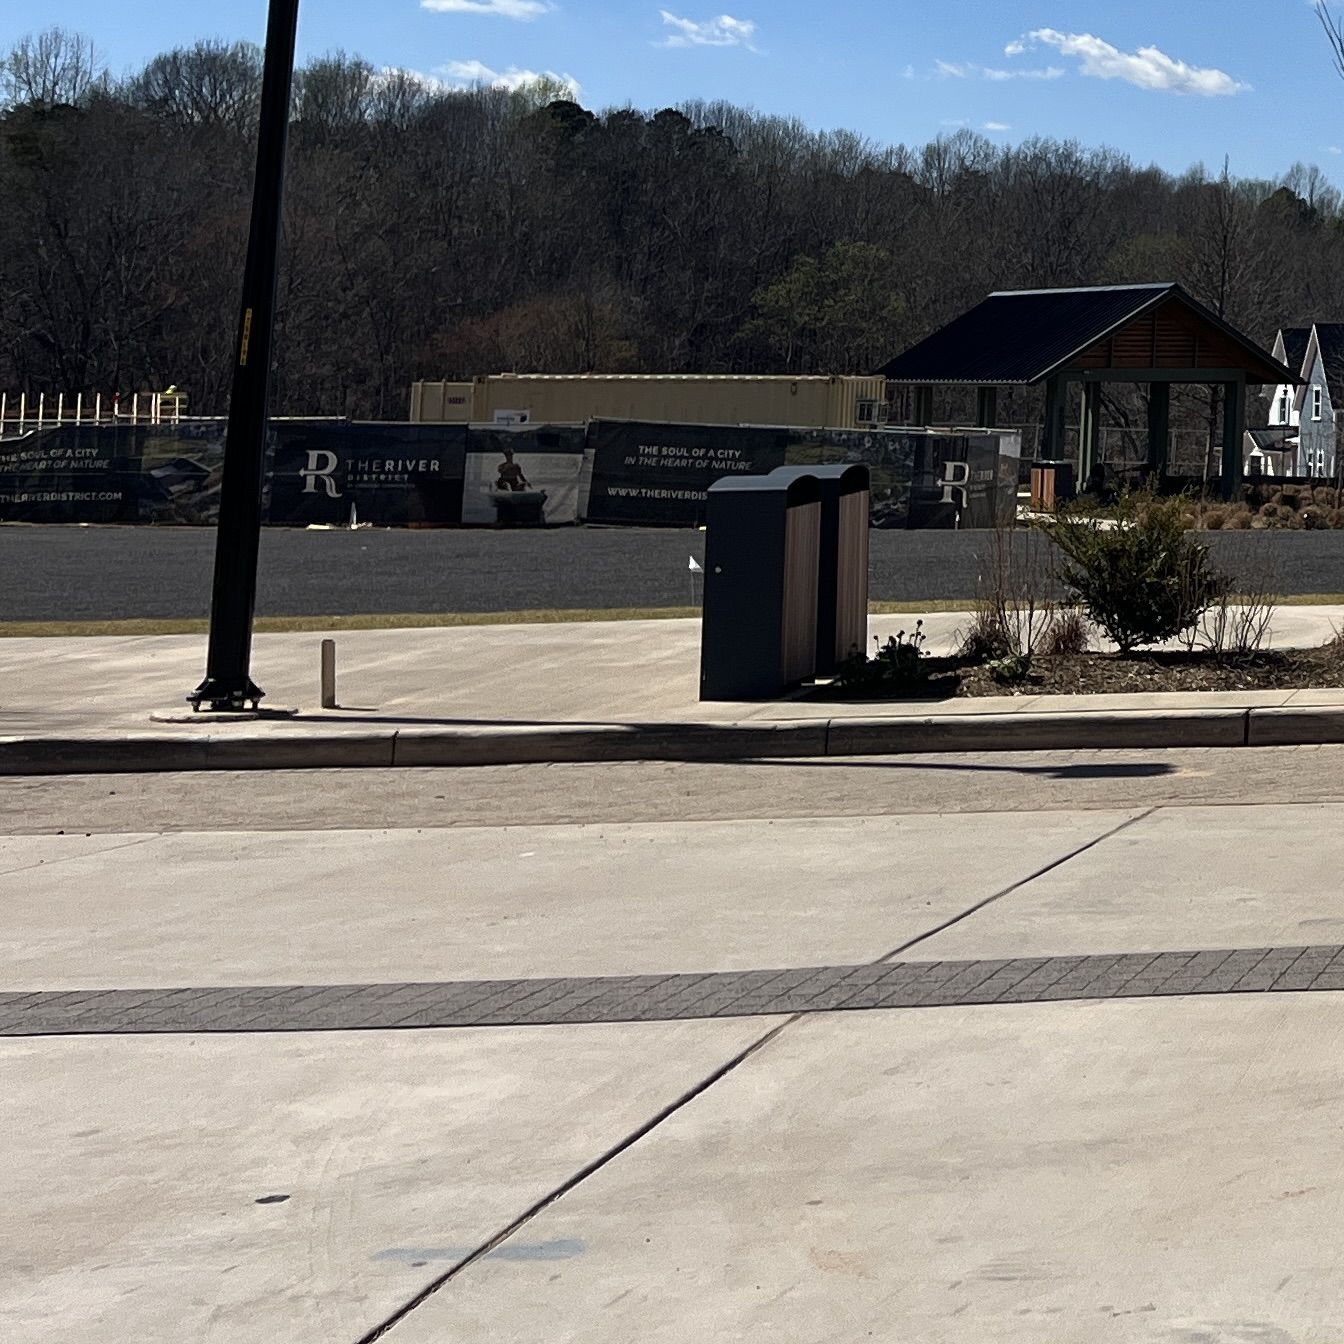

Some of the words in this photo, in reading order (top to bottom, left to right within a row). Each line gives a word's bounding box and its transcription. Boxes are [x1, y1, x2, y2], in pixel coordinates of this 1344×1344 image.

[49, 449, 64, 457] OF
[65, 449, 73, 457] A
[75, 449, 99, 457] CITY
[638, 445, 659, 455] THE
[661, 446, 688, 456] SOUL
[691, 448, 706, 457] OF
[707, 449, 716, 457] A
[717, 449, 742, 459] CITY
[70, 459, 110, 469] NATURE
[624, 456, 637, 465] IN
[638, 456, 660, 466] THE
[660, 458, 694, 467] HEART
[695, 459, 710, 468] OF
[711, 460, 752, 471] NATURE
